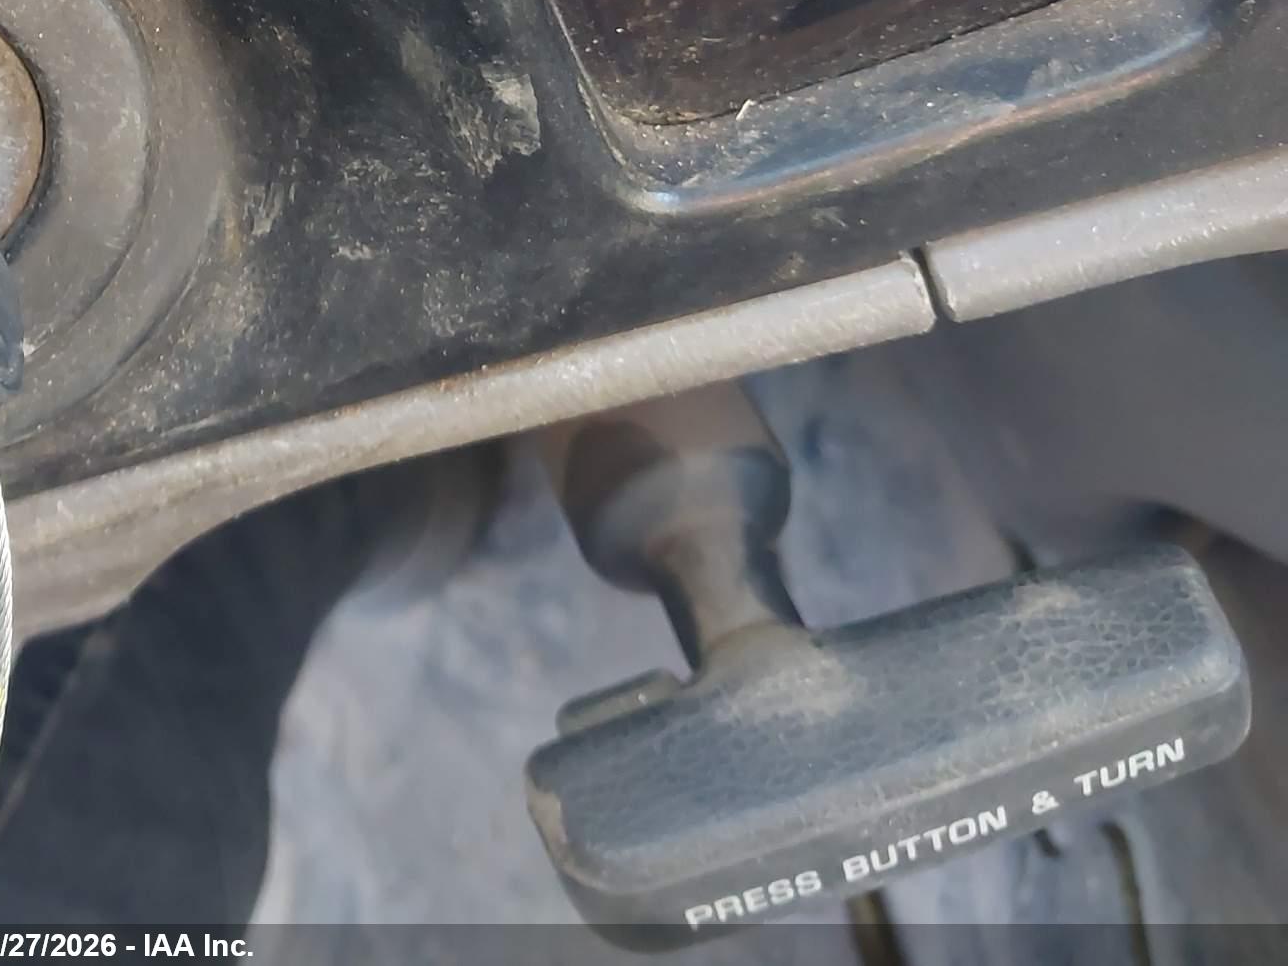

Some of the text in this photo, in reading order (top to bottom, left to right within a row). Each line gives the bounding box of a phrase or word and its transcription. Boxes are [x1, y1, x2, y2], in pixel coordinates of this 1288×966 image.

[684, 737, 1186, 932] PRESS BUTTON & TURN
